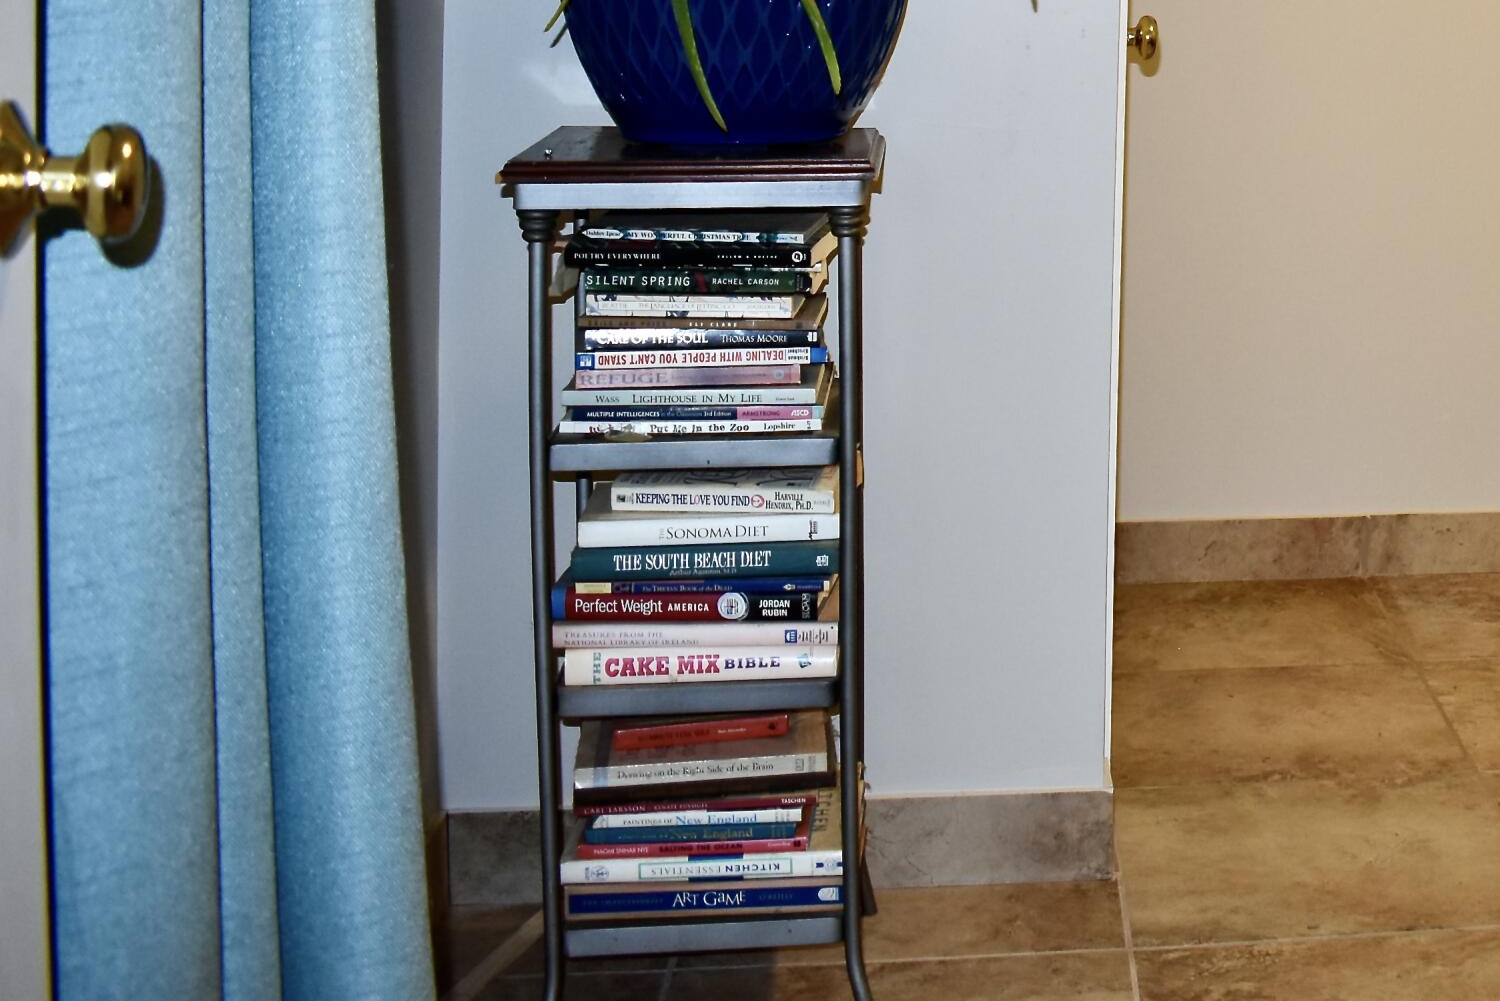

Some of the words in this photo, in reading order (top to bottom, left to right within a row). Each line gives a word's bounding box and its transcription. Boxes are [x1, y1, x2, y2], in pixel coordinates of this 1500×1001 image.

[586, 275, 635, 286] SILENT
[641, 275, 691, 287] SPRING
[747, 278, 780, 286] CARSON
[631, 332, 647, 345] OF
[651, 332, 674, 344] THE
[676, 331, 708, 344] SOUL
[721, 335, 755, 344] THOMAS
[756, 334, 788, 343] MOORE
[598, 355, 627, 366] STAND
[630, 354, 655, 365] CAN'T
[660, 353, 678, 364] YOU
[682, 352, 716, 363] PEOPLE
[720, 351, 742, 362] WITH
[746, 350, 784, 361] DEALING
[580, 372, 668, 386] REFUGE
[632, 394, 697, 404] LIGHTHOUSE
[702, 394, 713, 403] IN
[741, 393, 763, 403] LIFE
[650, 424, 669, 433] Put
[673, 424, 688, 433] Me
[708, 423, 726, 432] the
[729, 423, 750, 432] Zoo
[763, 422, 796, 431] Lopshire
[635, 493, 670, 505] KEEPING
[671, 494, 688, 505] THE
[689, 494, 711, 506] LOVE
[712, 494, 730, 506] YOU
[731, 495, 750, 507] FIND
[666, 526, 732, 540] SONOMA
[735, 525, 769, 538] DIET
[613, 554, 641, 571] THE
[645, 553, 690, 570] SOUTH
[694, 551, 736, 569] BEACH
[741, 550, 771, 568] DIET
[575, 598, 618, 613] Perfect
[620, 598, 663, 616] Weight
[667, 603, 709, 611] AMERICA
[759, 599, 791, 608] JORDAN
[762, 608, 788, 616] RUBIN
[593, 652, 601, 684] THE
[604, 656, 670, 678] CAKE
[677, 654, 720, 675] MIX
[724, 656, 780, 669] BIBLE
[617, 770, 652, 780] Drawing
[667, 768, 680, 776] the
[682, 767, 705, 777] Right
[707, 765, 723, 773] Side
[726, 763, 736, 772] of
[737, 763, 750, 771] the
[752, 762, 774, 771] Brain
[608, 805, 646, 813] LARSSON
[676, 816, 703, 825] New
[707, 813, 757, 825] England
[651, 864, 720, 876] ESSENTIALS
[725, 863, 780, 873] KITCHEN
[672, 892, 699, 908] ART
